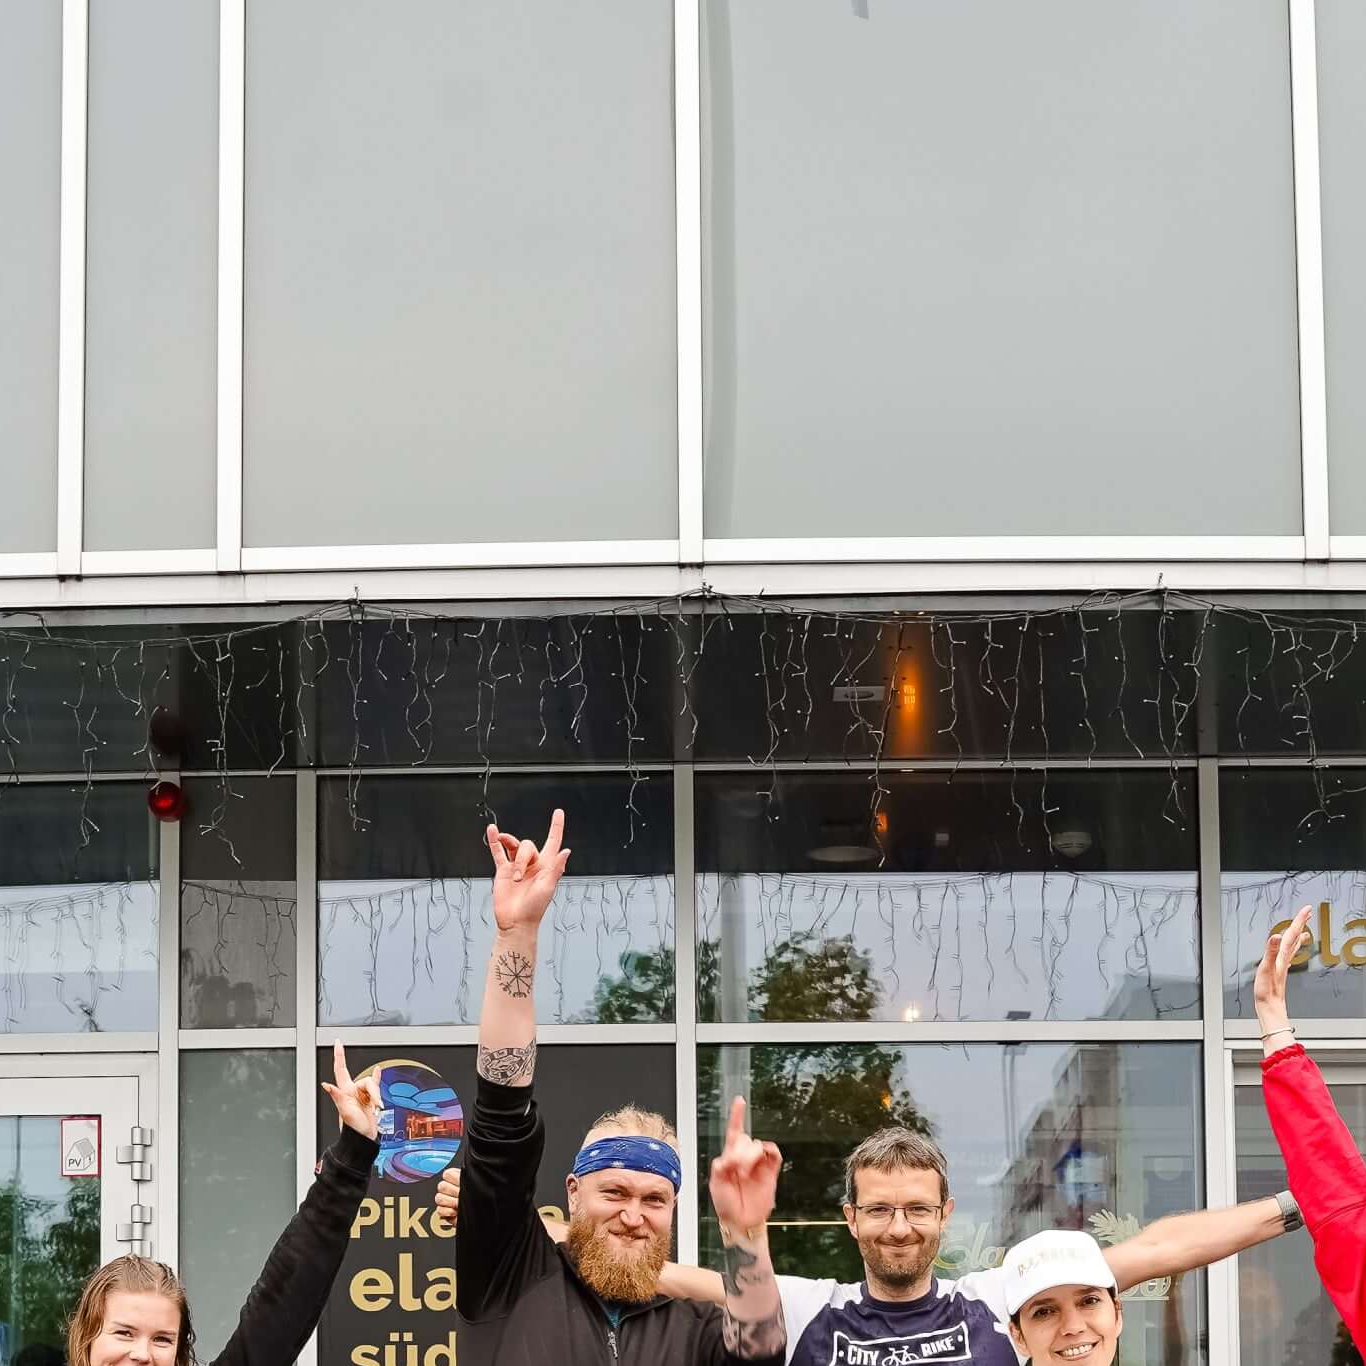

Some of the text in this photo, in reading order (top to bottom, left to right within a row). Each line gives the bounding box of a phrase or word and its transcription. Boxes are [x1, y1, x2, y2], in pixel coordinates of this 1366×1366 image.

[68, 1158, 82, 1168] PV
[847, 1336, 955, 1366] CITY BIKE
